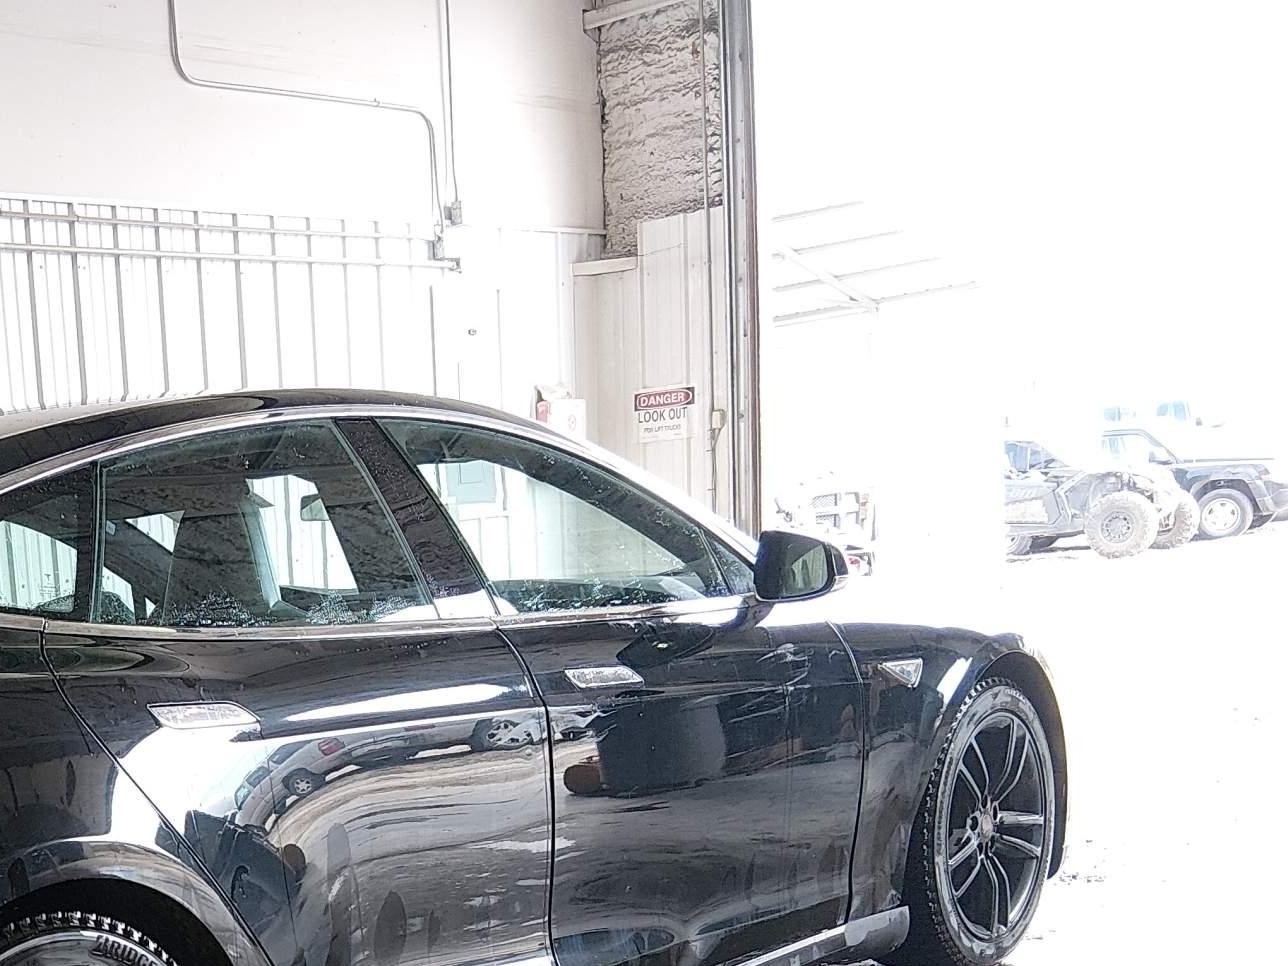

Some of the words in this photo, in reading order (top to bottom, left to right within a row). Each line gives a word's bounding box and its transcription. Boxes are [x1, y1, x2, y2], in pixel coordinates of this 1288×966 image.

[640, 392, 685, 406] DANGER
[638, 409, 666, 423] LOOK
[669, 407, 687, 420] OUT
